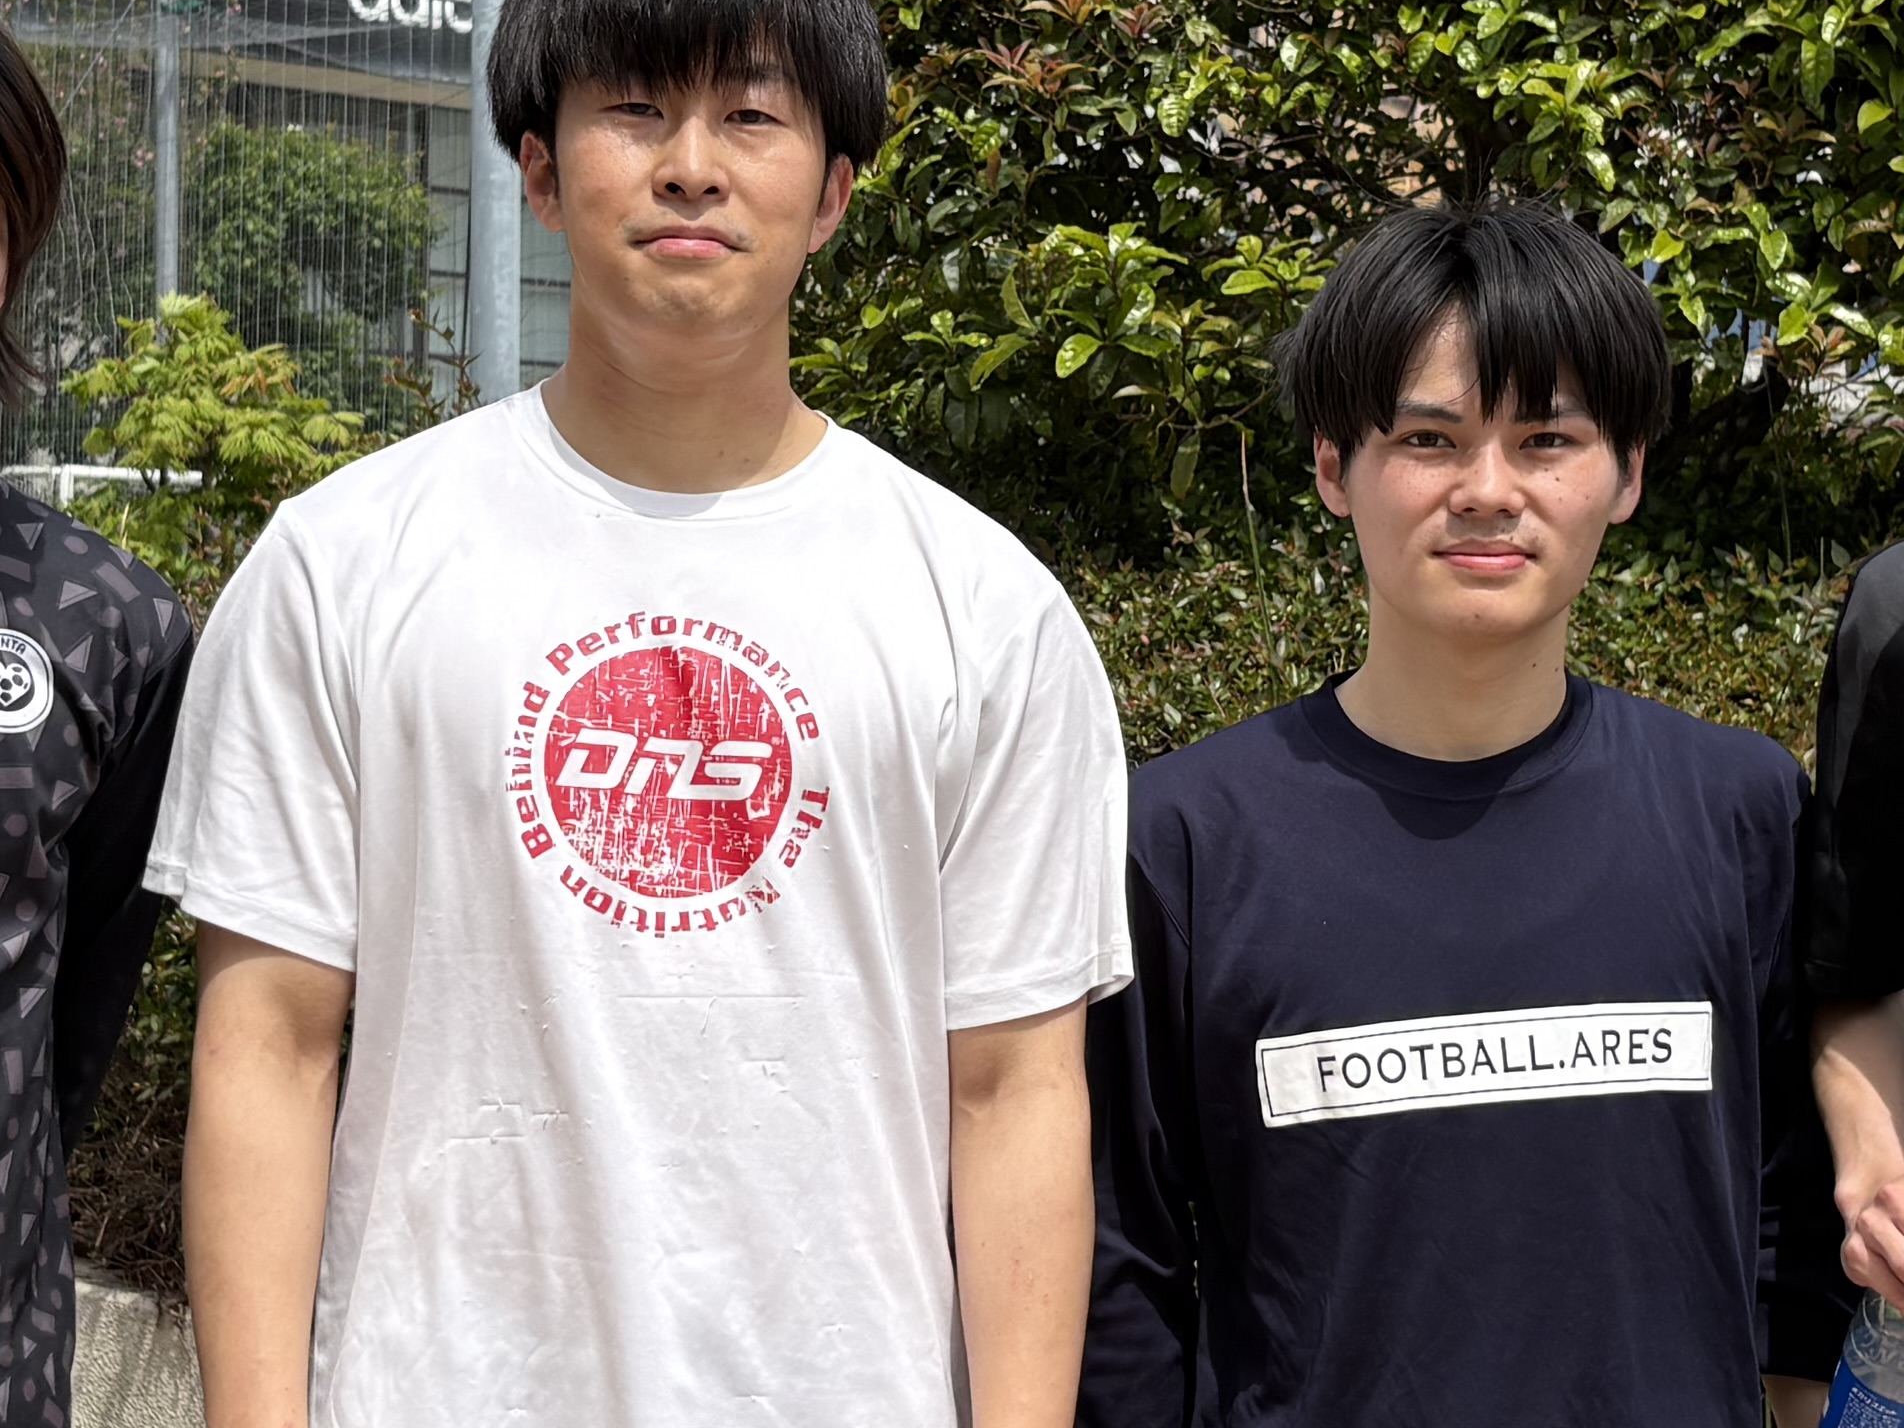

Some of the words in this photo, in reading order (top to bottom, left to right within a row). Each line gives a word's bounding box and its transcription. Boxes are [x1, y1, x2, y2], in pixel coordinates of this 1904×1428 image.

[544, 610, 821, 741] Performance
[778, 785, 831, 868] The
[558, 863, 783, 940] Nutrition
[1316, 1027, 1675, 1093] FOOTBALL.ARES
